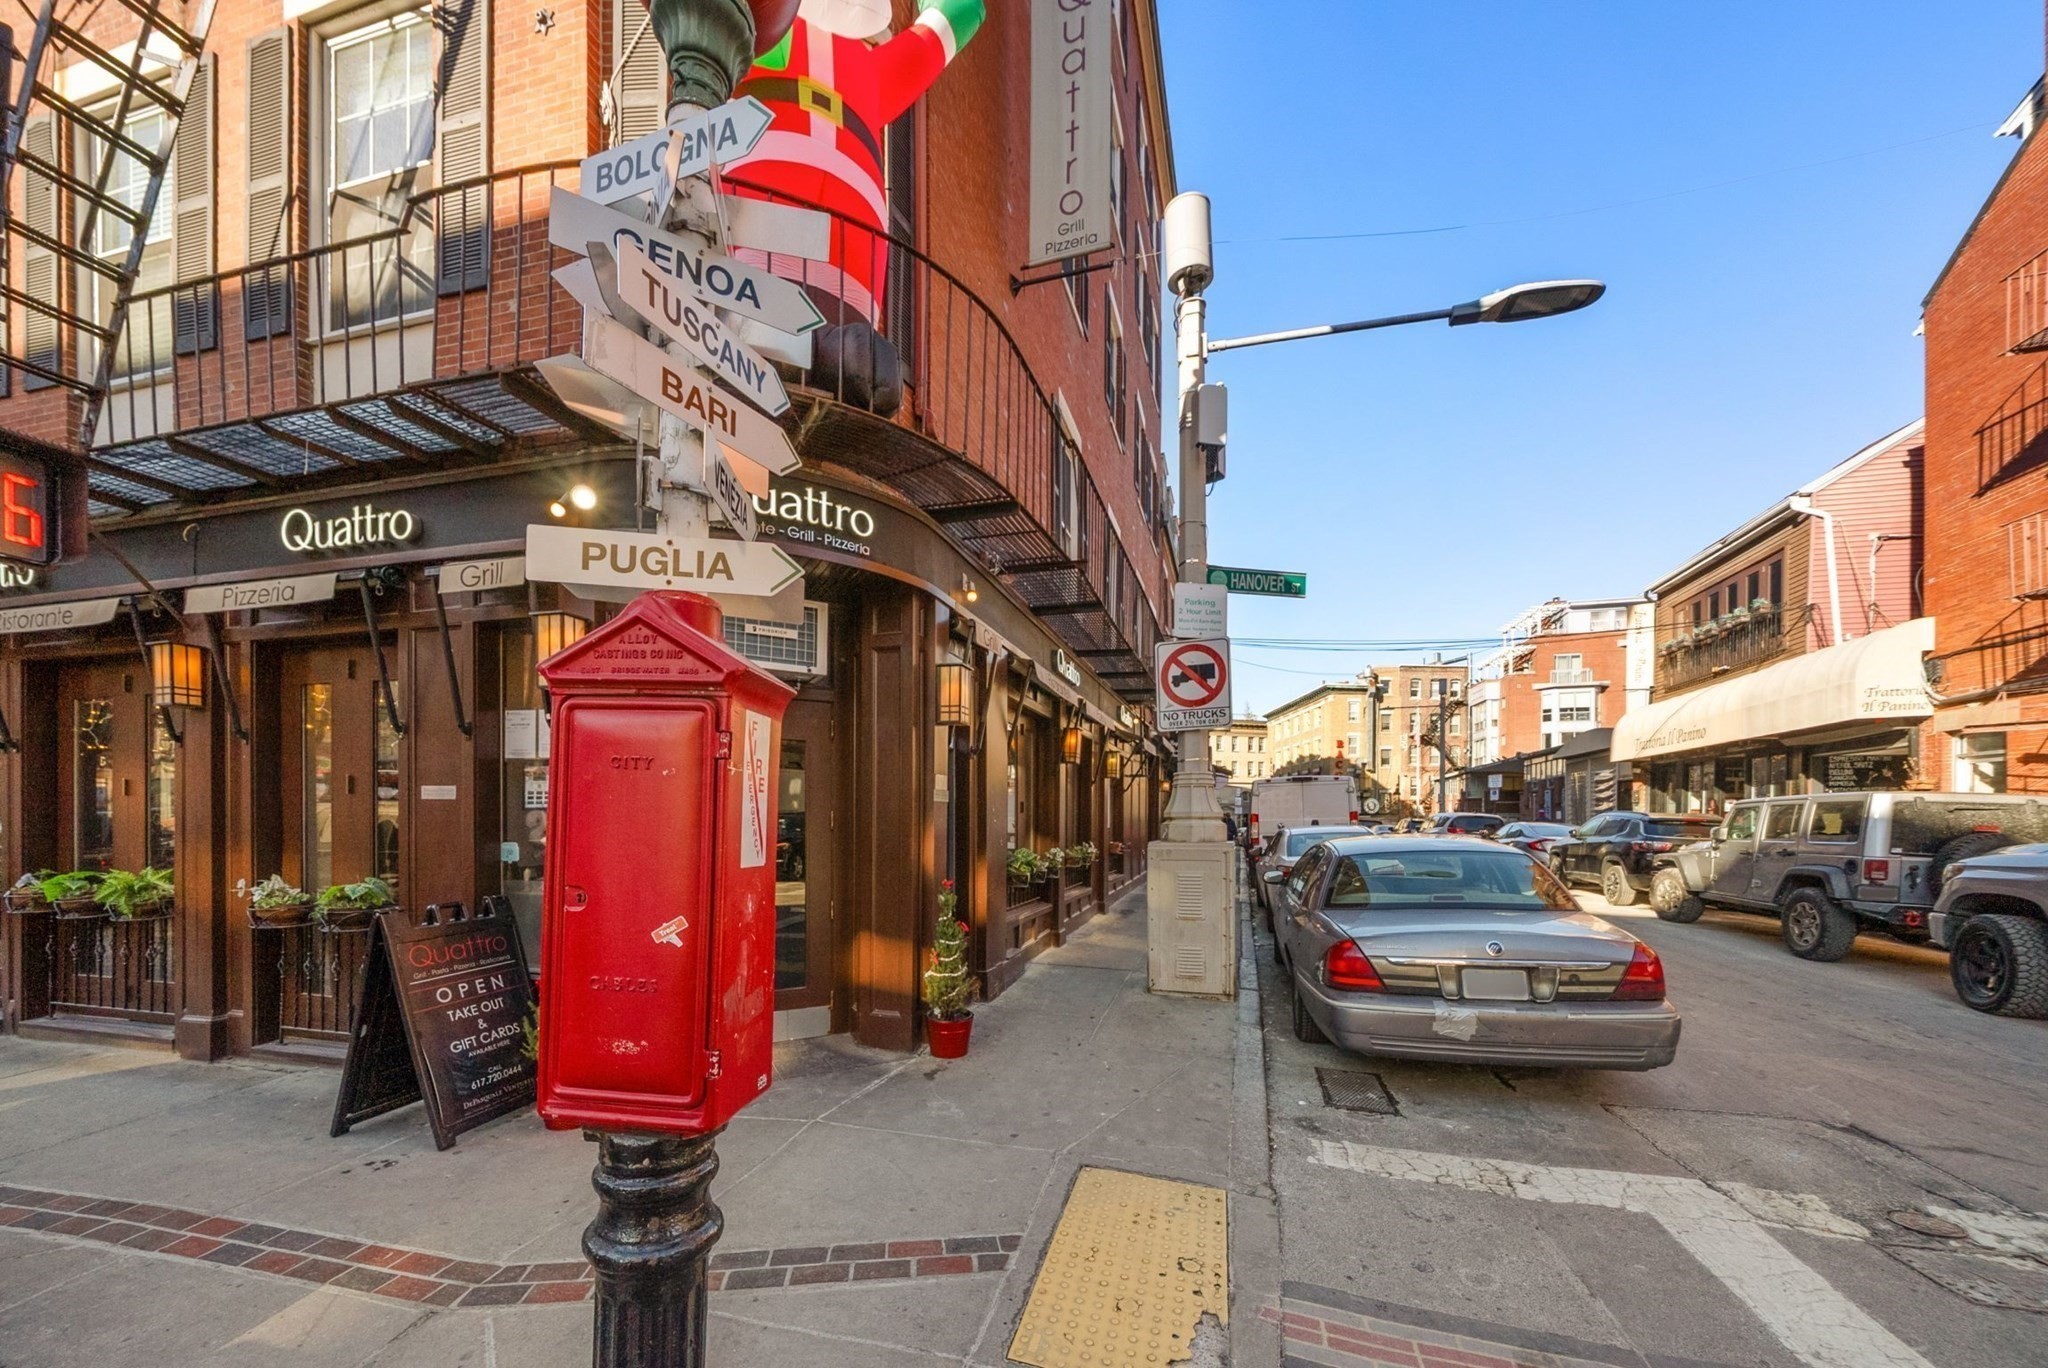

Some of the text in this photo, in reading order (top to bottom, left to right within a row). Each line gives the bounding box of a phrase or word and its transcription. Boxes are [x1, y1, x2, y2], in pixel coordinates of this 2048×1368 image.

[596, 117, 738, 193] BOLOGNA
[1058, 218, 1084, 236] Grill
[1045, 231, 1098, 255] Pizzeria
[641, 268, 766, 394] TUSCANY
[661, 366, 736, 437] BARI
[714, 454, 749, 531] VENEZIA
[3, 472, 43, 547] 6
[752, 487, 874, 537] uattro
[281, 504, 413, 551] Quattro
[787, 526, 815, 543] Grill
[824, 533, 871, 556] Pizzeria
[581, 541, 735, 581] PUGLIA
[461, 562, 504, 587] Grill
[1230, 572, 1285, 592] HANOVER
[1291, 582, 1301, 593] ST
[222, 582, 296, 608] Pizzeria
[1184, 598, 1216, 608] Parking
[618, 634, 658, 644] ALLOY
[594, 649, 684, 660] CASTINGS CO INC
[1864, 685, 1925, 697] Trattoria
[1163, 709, 1226, 721] NO TRUCKS
[1878, 701, 1928, 712] Panino
[1677, 725, 1707, 743] Panino
[610, 755, 655, 770] CITY
[752, 721, 765, 793] FIRE
[409, 936, 507, 967] Quattro
[431, 967, 449, 976] Pasta
[436, 974, 504, 1003] OPEN
[446, 997, 504, 1021] TAKE OUT
[478, 1018, 488, 1029] &
[450, 1022, 520, 1053] GIFT CARDS
[468, 1039, 511, 1057] AVAILABLE HERE
[471, 1064, 522, 1090] 617.720.0444
[488, 1064, 502, 1073] CALL
